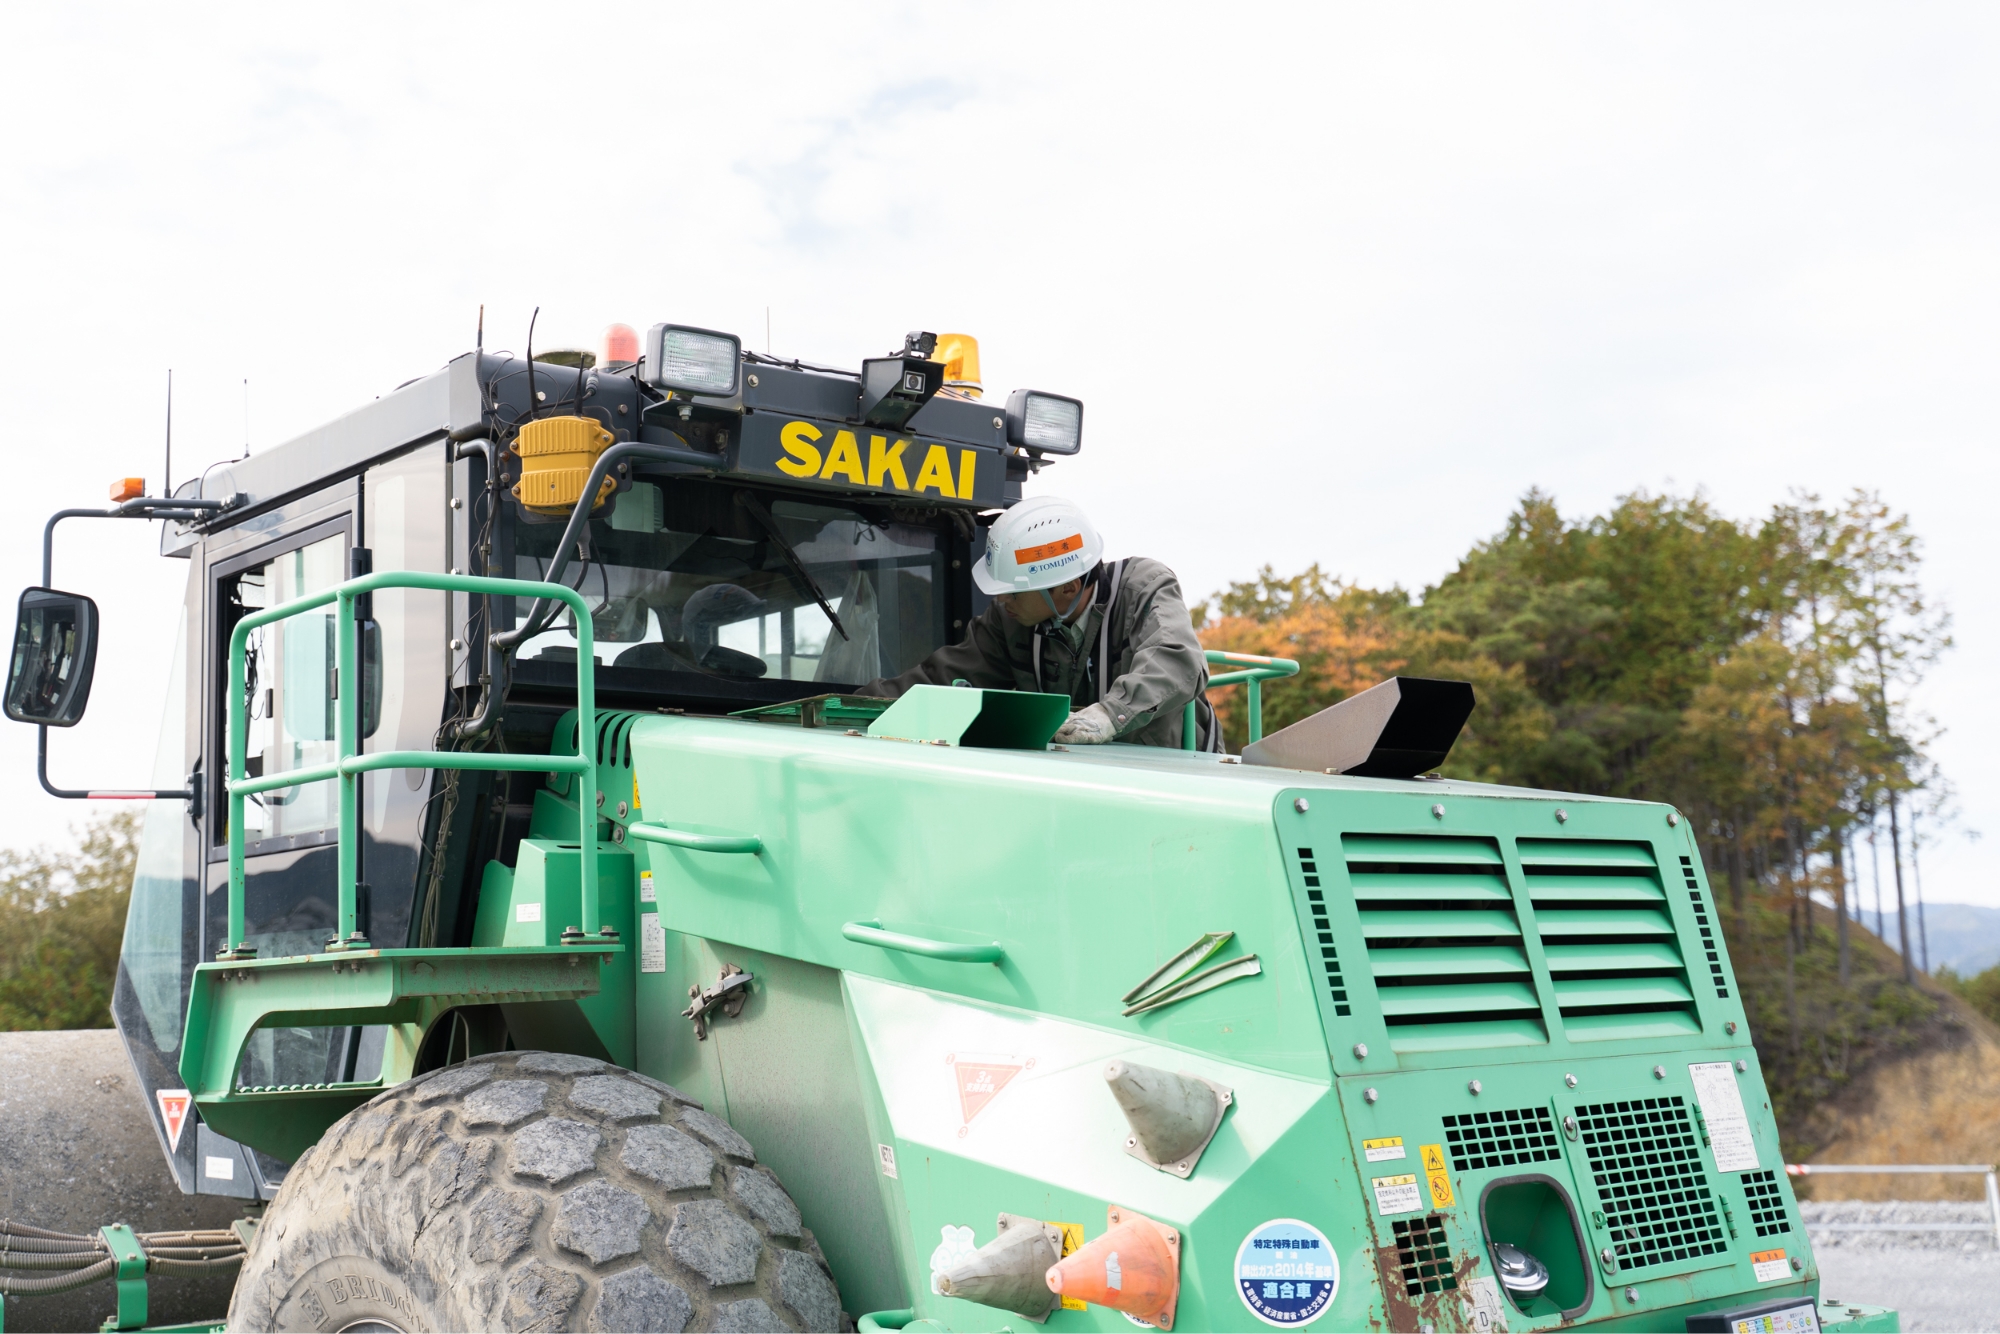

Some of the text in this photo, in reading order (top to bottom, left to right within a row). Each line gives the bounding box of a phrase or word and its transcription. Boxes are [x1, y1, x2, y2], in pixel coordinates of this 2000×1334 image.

[775, 421, 977, 500] SAKAI
[1038, 553, 1080, 572] TOMIJIMA
[1254, 1239, 1320, 1249] 特定特殊自動車
[1262, 1282, 1312, 1299] 適合車
[1480, 1311, 1489, 1327] D
